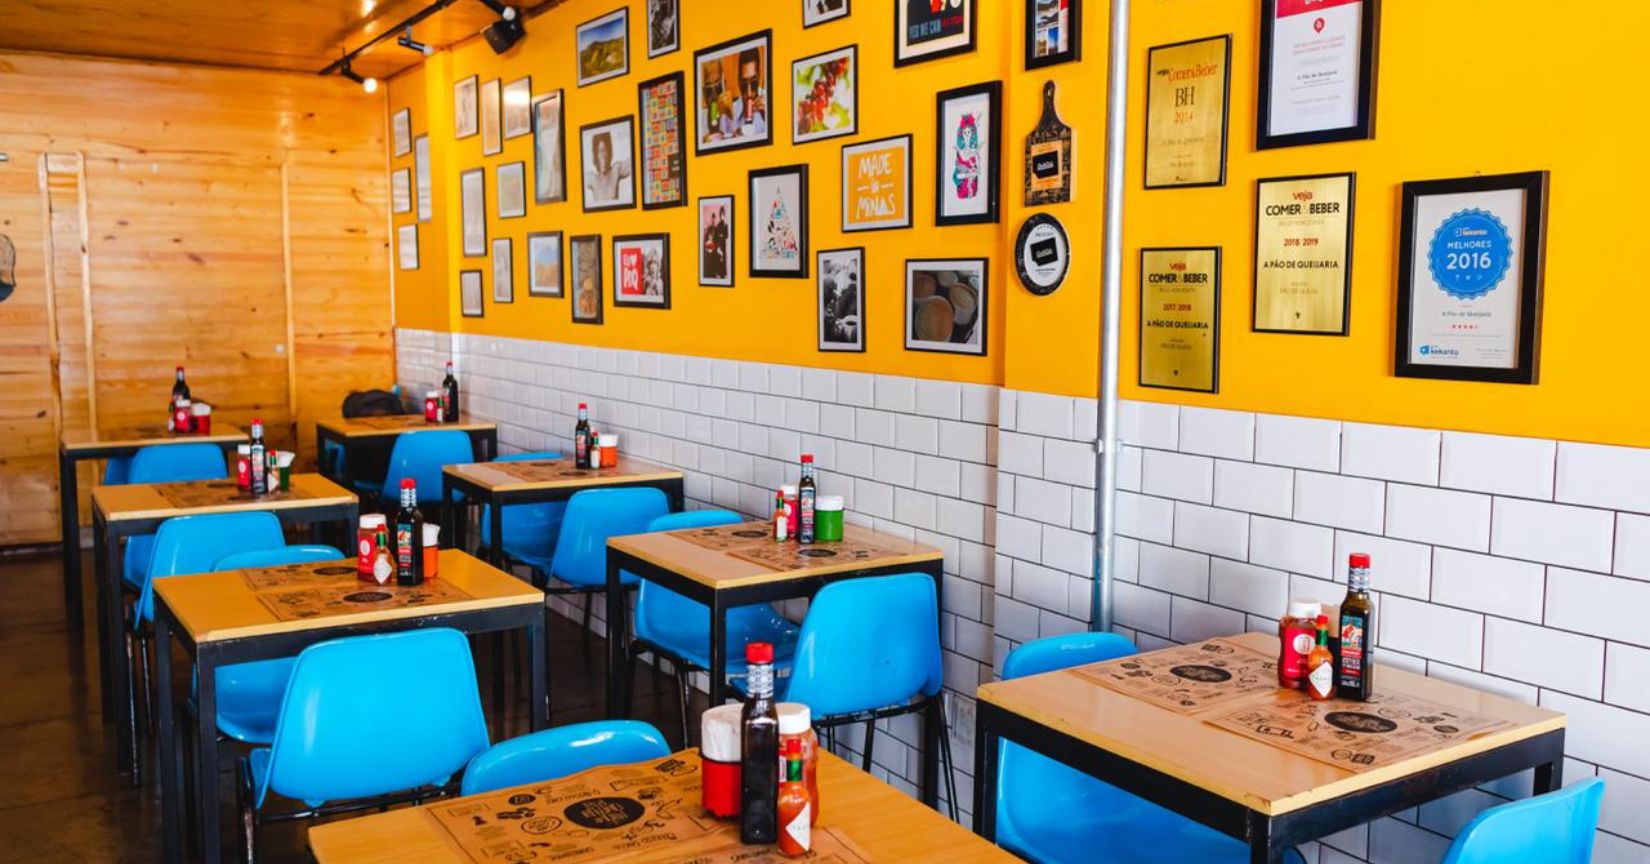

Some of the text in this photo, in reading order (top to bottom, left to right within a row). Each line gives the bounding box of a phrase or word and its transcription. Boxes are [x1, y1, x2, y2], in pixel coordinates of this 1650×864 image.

[1175, 86, 1195, 107] BH
[1174, 111, 1193, 124] 2014
[858, 152, 893, 179] MADE
[1293, 190, 1313, 203] veja
[1265, 204, 1302, 216] COMER
[1309, 202, 1340, 214] BEBER
[1283, 237, 1319, 247] 2018 2019
[1447, 240, 1492, 250] MELHORES
[1263, 260, 1269, 269] A
[1269, 259, 1285, 269] PÃO
[1286, 260, 1296, 269] DE
[1446, 252, 1491, 270] 2016
[1149, 273, 1177, 283] COMER
[1183, 273, 1208, 283] BEBER
